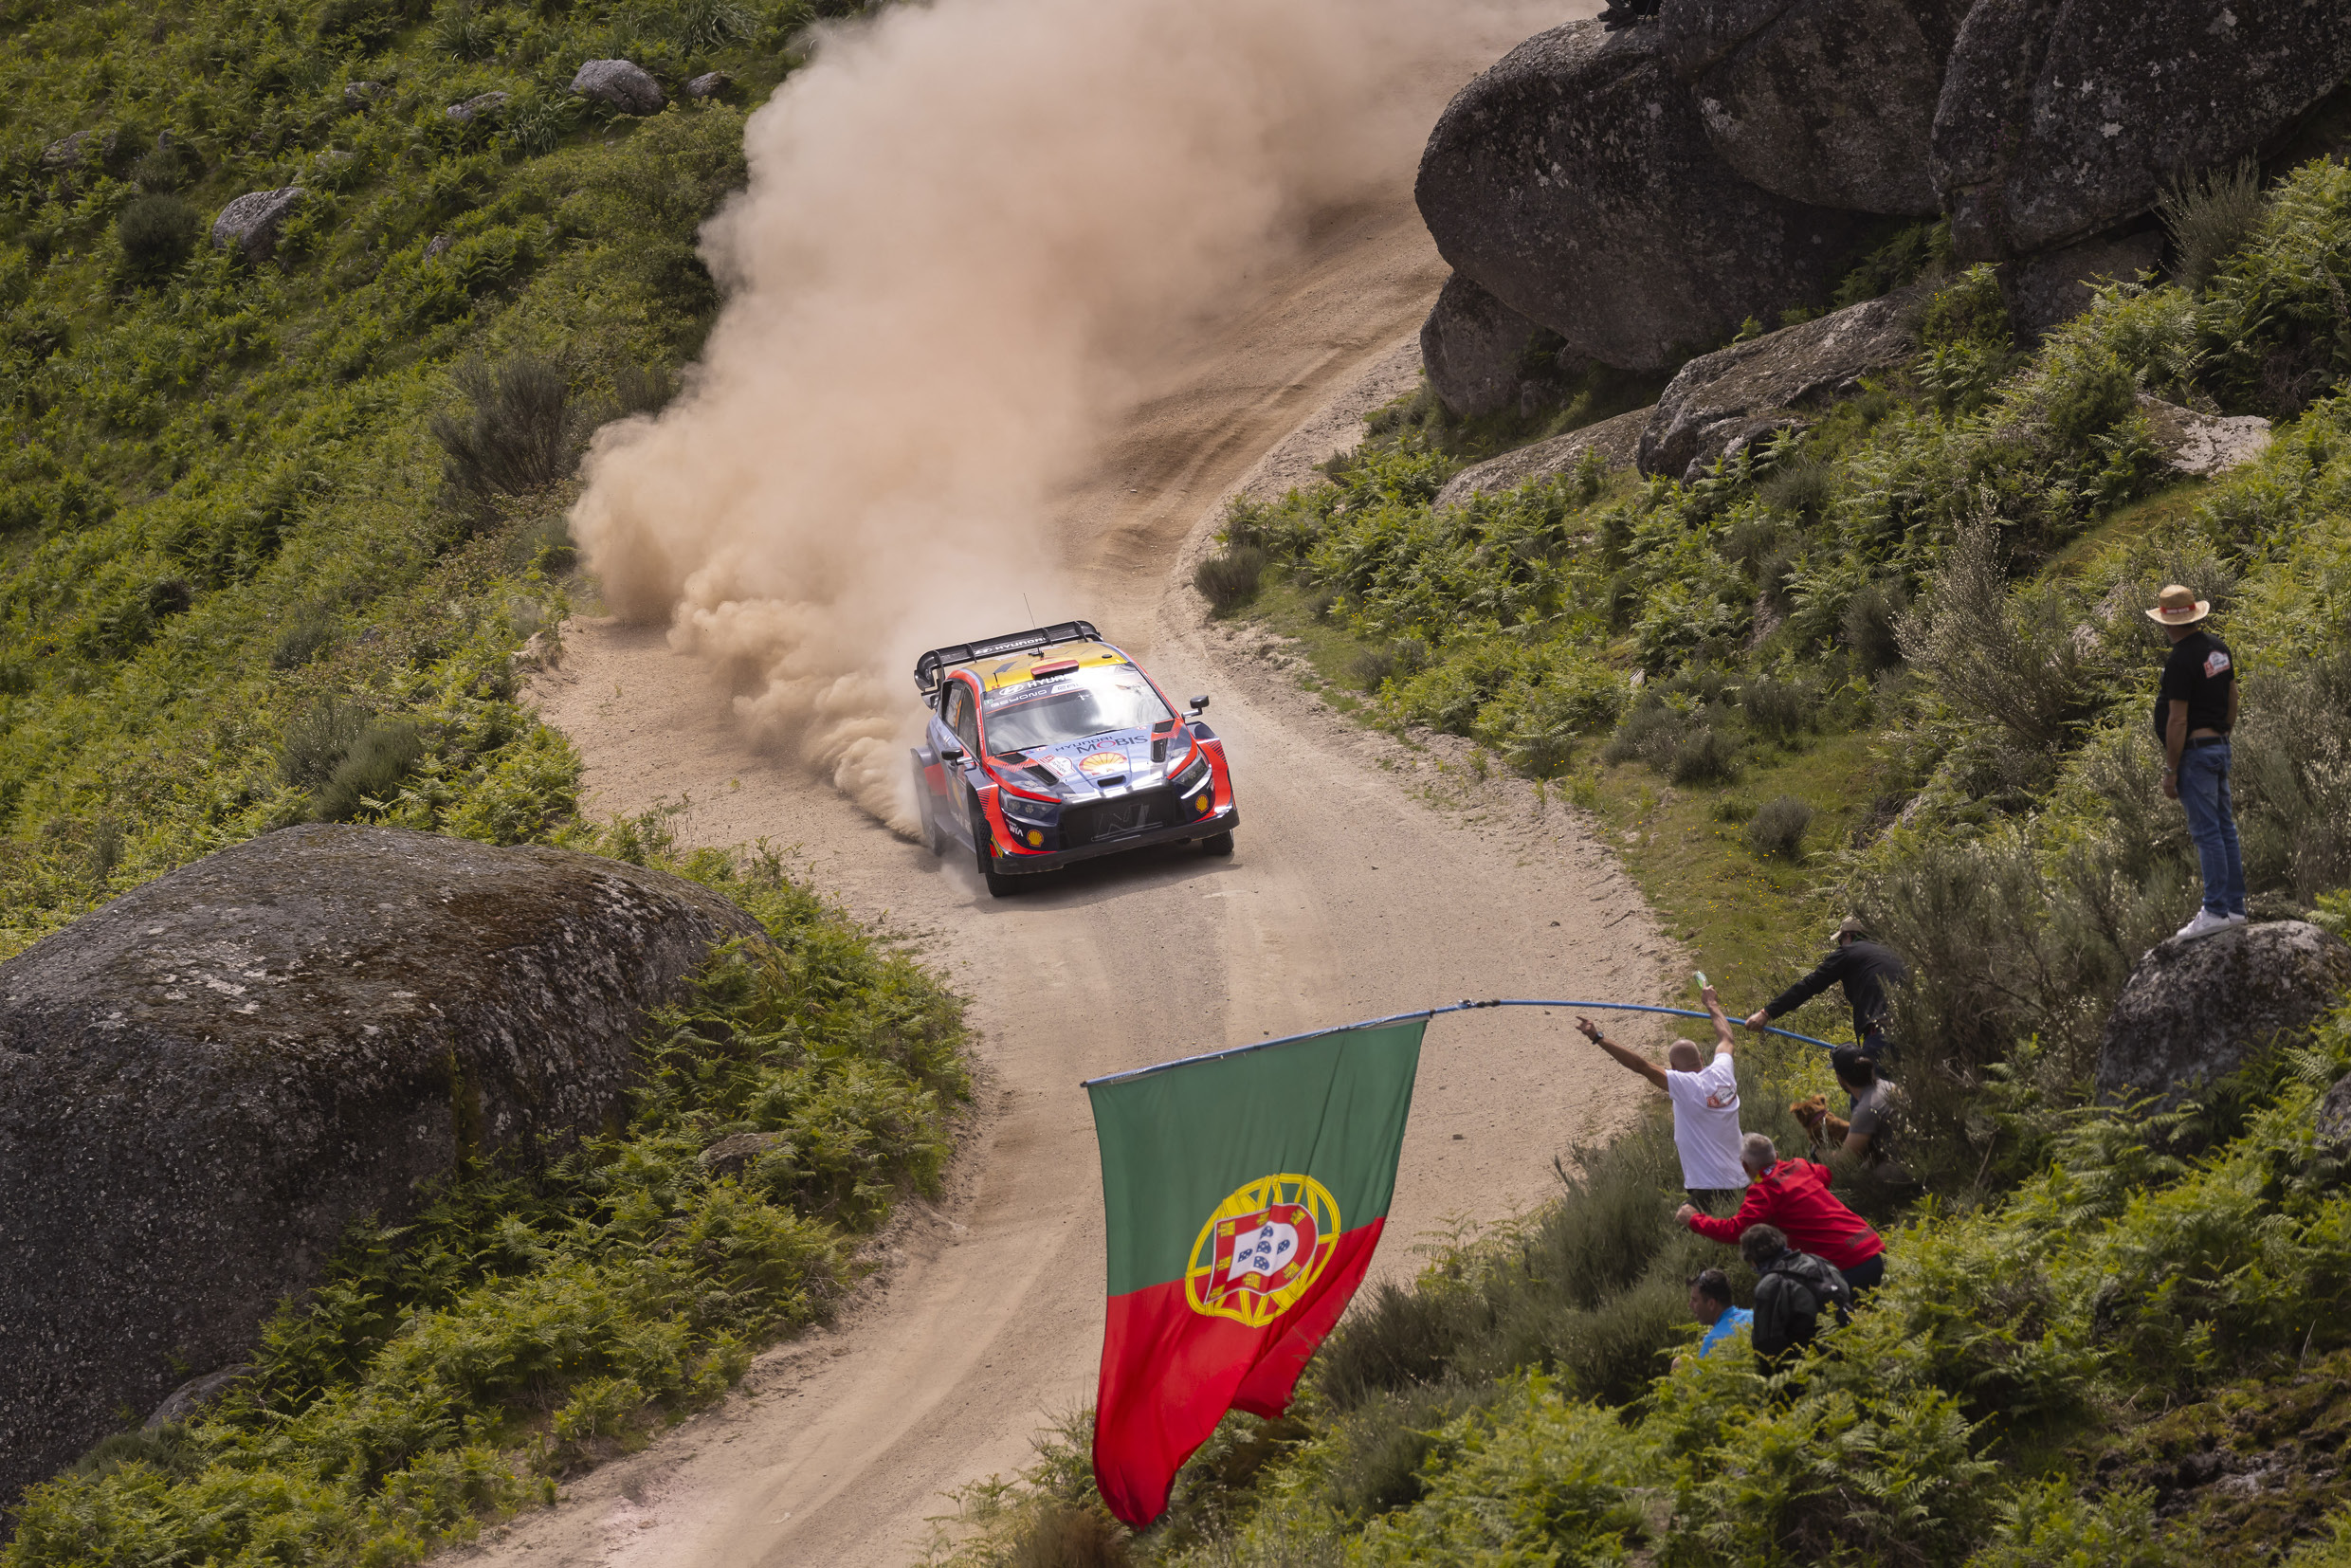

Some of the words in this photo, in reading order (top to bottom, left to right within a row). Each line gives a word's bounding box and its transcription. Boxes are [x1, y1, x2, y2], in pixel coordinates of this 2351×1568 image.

[991, 690, 1048, 707] BEYOND
[1055, 736, 1113, 752] HYUNDAI
[1077, 735, 1148, 755] MOBIS
